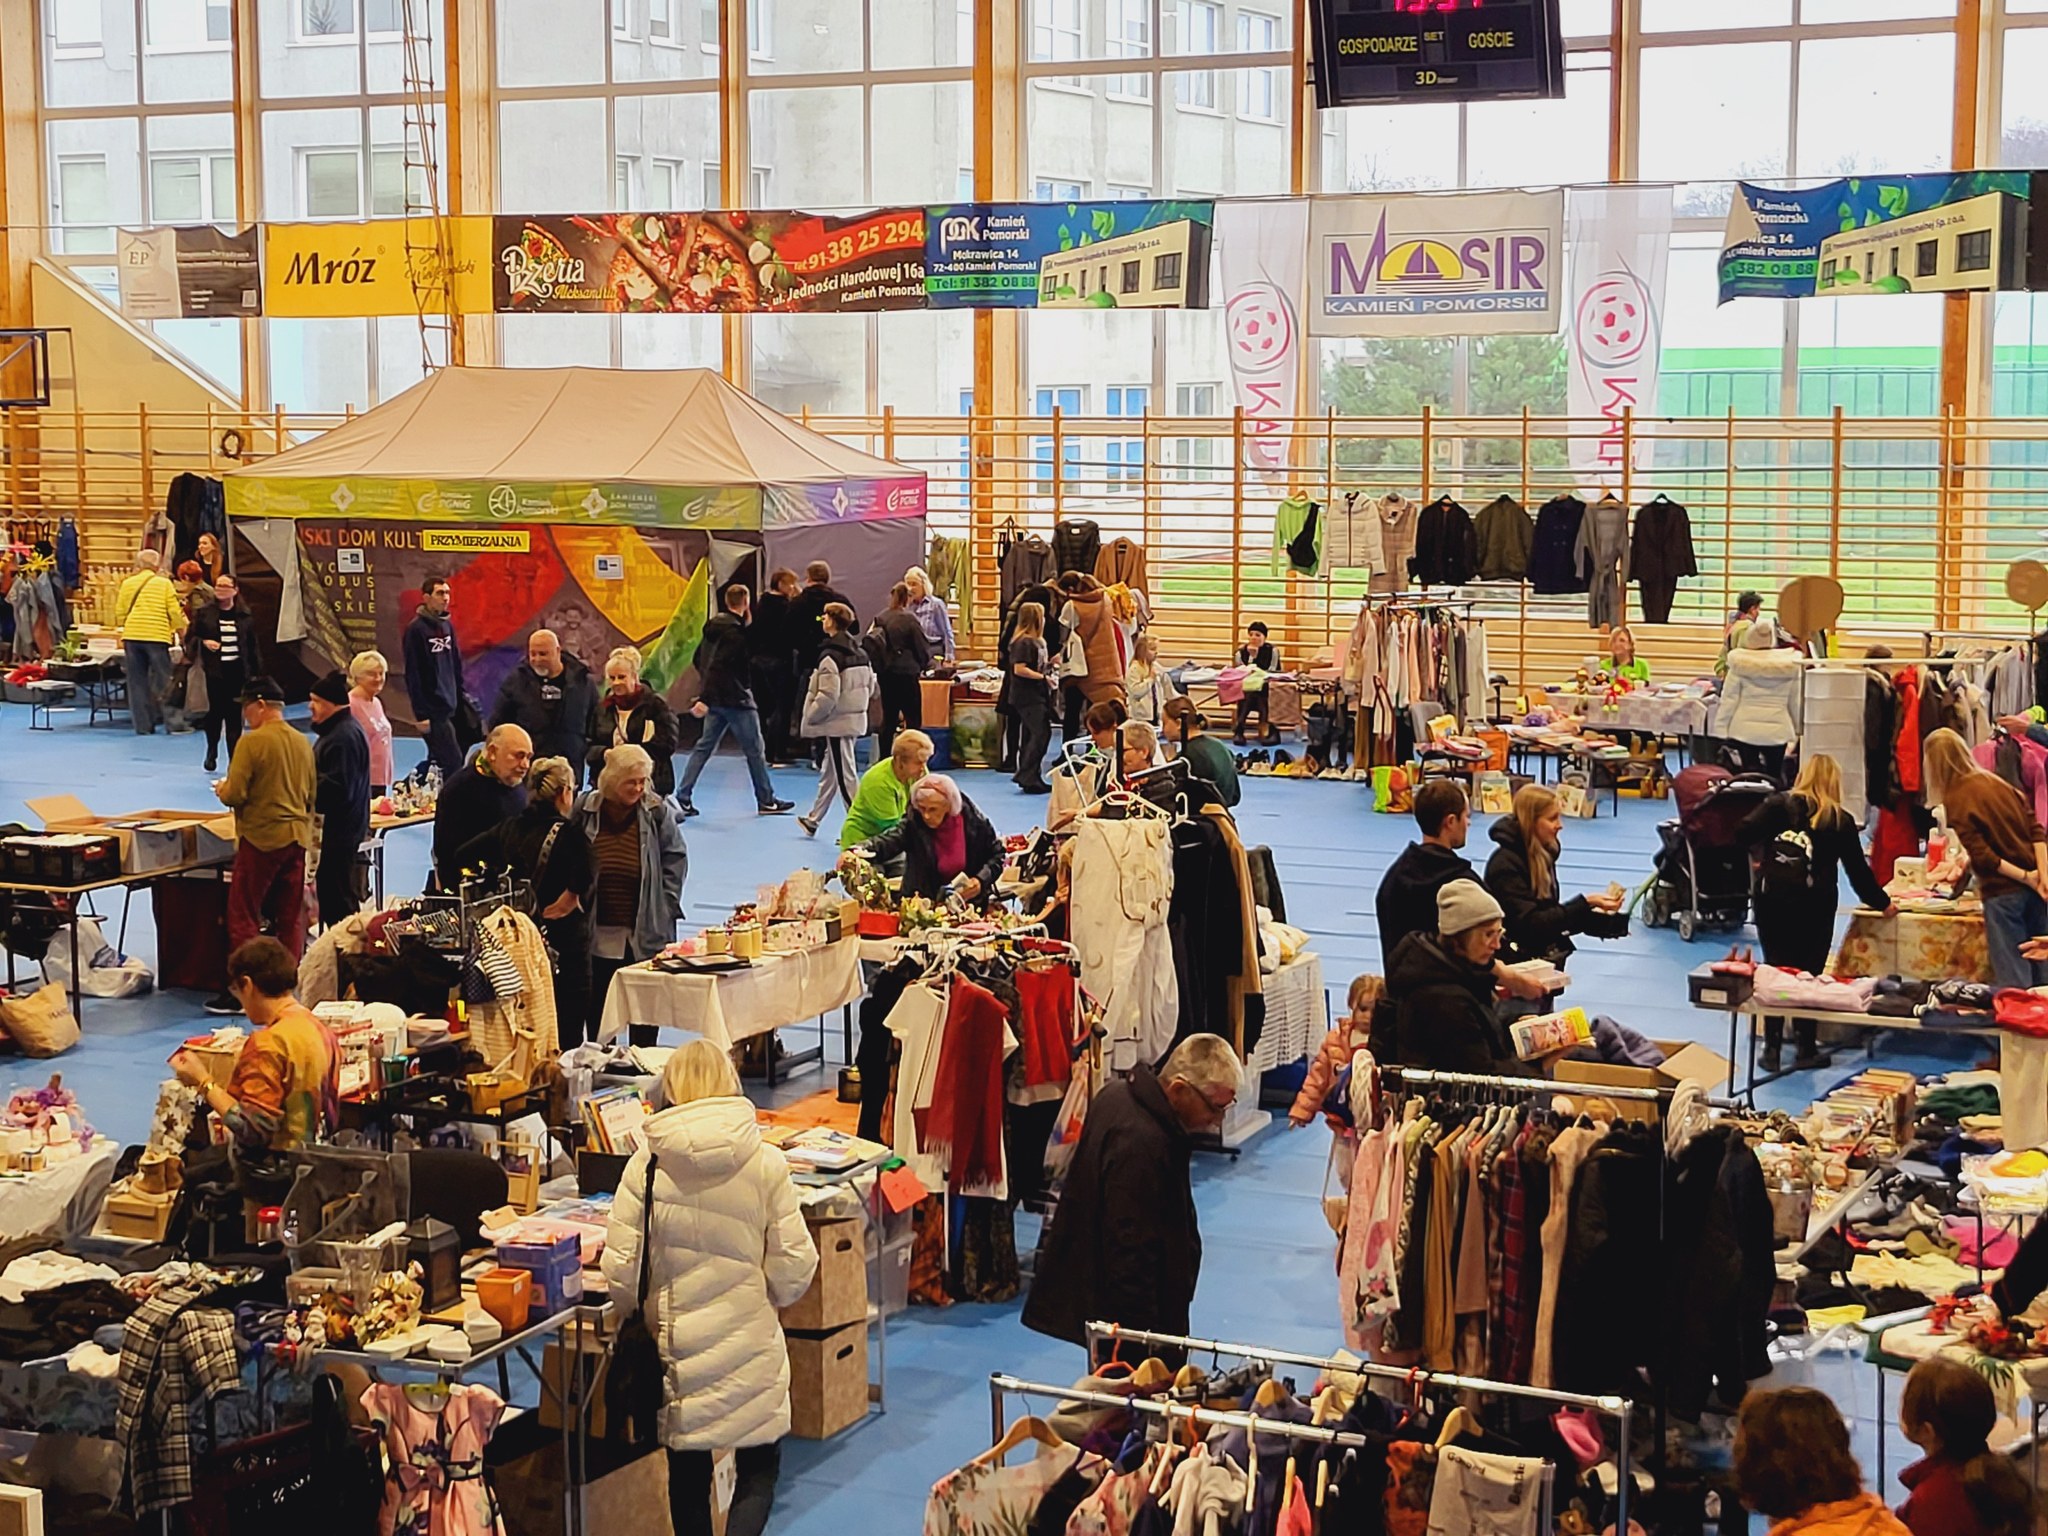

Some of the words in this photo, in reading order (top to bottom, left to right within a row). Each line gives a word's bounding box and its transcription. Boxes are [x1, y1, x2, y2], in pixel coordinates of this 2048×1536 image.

[1338, 36, 1418, 55] GOSPODARZE
[1424, 31, 1444, 42] SET
[1468, 27, 1515, 49] GOŚCIE
[987, 215, 1025, 228] Kamień
[857, 226, 880, 253] 25
[885, 219, 924, 245] 294
[982, 228, 1030, 241] Pomorski
[1779, 233, 1794, 243] 14
[129, 251, 149, 265] EP
[952, 250, 1005, 260] Mokrawica
[1006, 249, 1019, 259] 14
[283, 247, 377, 286] Mróz
[965, 261, 996, 271] Kamień
[998, 260, 1036, 271] Pomorski
[1770, 263, 1791, 275] 08
[1795, 263, 1814, 274] 88
[772, 293, 786, 306] ul.
[787, 275, 838, 302] Jedności
[840, 263, 902, 289] Narodowej
[903, 262, 925, 279] 16a
[933, 278, 957, 289] Tel:
[960, 278, 970, 288] 91
[973, 277, 997, 288] 382
[1001, 277, 1019, 287] 08
[841, 286, 877, 303] Kamień
[878, 283, 925, 298] Pomorski
[1325, 297, 1415, 313] KAMIEŃ
[1422, 296, 1547, 312] POMORSKI
[338, 529, 377, 547] DOM
[430, 534, 522, 548] PRZYMIERZALNIA
[334, 601, 376, 613] SKIE
